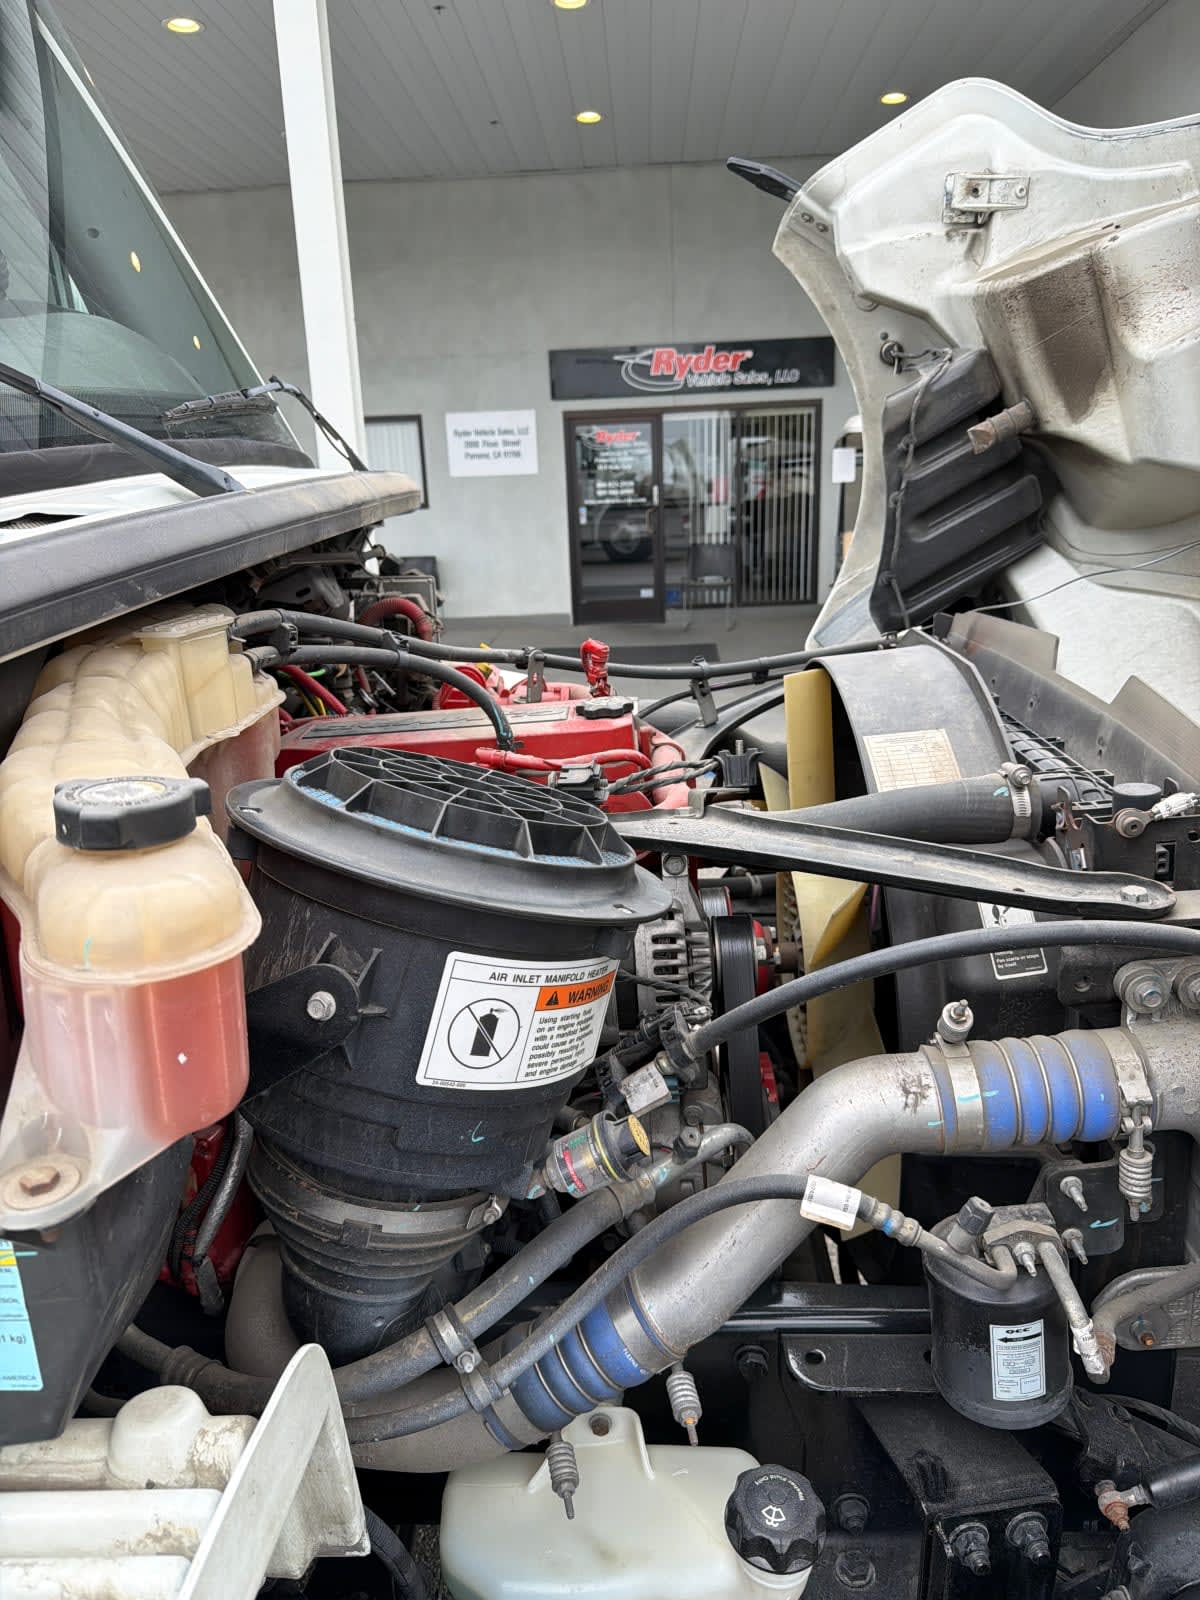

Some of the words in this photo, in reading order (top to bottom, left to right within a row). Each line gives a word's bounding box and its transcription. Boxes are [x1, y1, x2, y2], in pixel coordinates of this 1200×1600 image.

[650, 345, 749, 381] Ryder
[686, 373, 732, 388] Vehicle
[733, 371, 773, 386] Sales,
[774, 369, 801, 384] LLC
[595, 429, 640, 447] Ryder
[489, 972, 508, 982] AIR
[512, 973, 542, 984] INLET
[544, 971, 585, 983] MANIFOLD
[587, 965, 608, 979] HEATER
[568, 982, 609, 1003] WARNING
[539, 1017, 558, 1025] Using
[560, 1013, 580, 1021] starting
[557, 1023, 576, 1031] engine
[534, 1034, 548, 1042] with
[529, 1050, 556, 1061] possibly
[527, 1060, 549, 1069] severe
[524, 1069, 538, 1077] and
[9, 1334, 27, 1345] kg)
